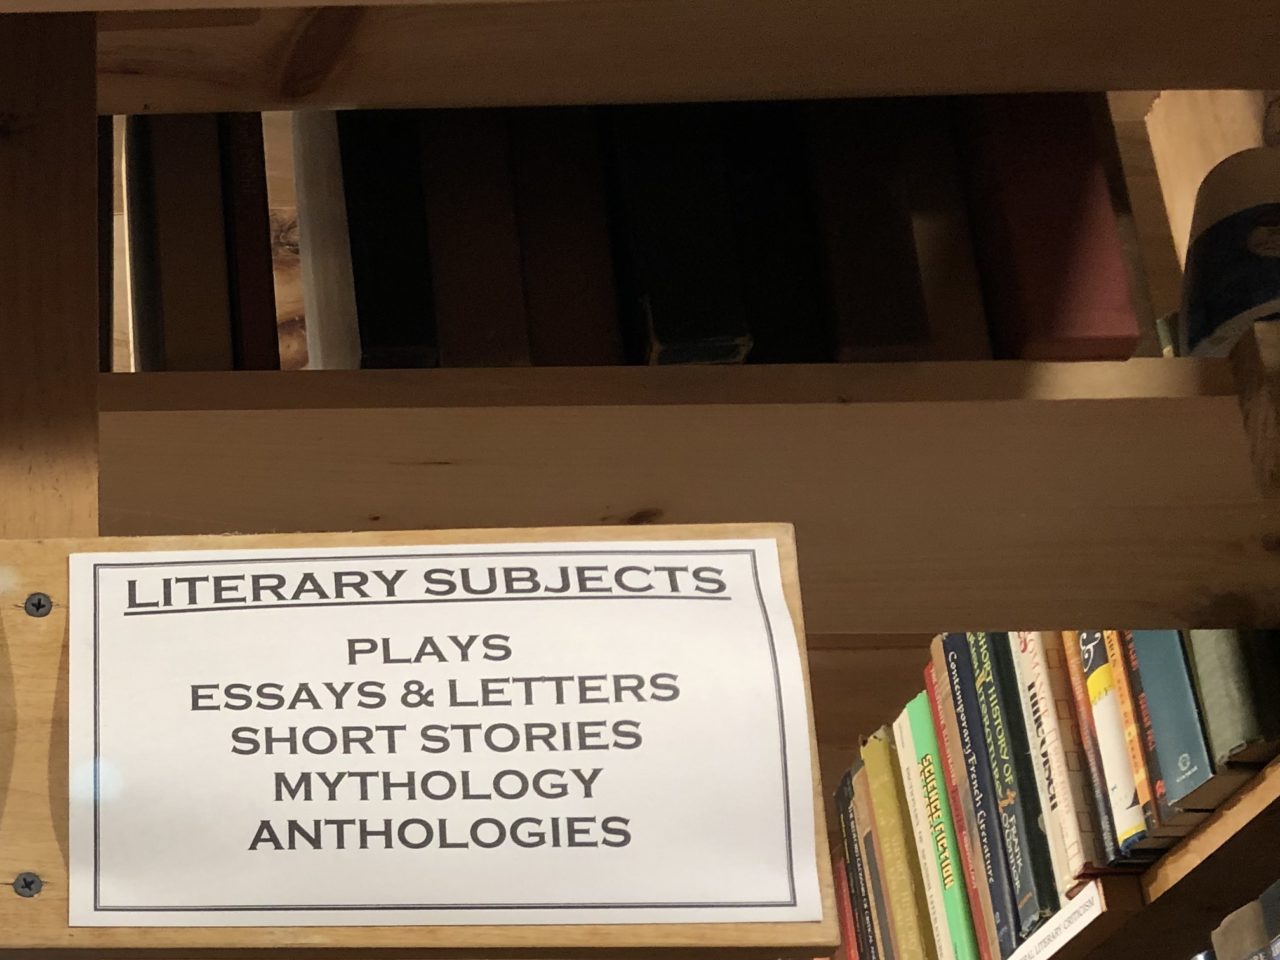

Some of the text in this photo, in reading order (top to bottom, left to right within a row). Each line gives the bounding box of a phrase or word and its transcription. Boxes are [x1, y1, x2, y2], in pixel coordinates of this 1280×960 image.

[126, 566, 729, 609] LITERARY SUBJECTS
[346, 634, 513, 665] PLAYS
[190, 672, 681, 712] ESSAYS & LETTERS
[229, 720, 643, 756] SHORT STORIES
[986, 686, 1009, 759] HISTORY
[1001, 763, 1014, 784] OF
[273, 768, 604, 801] MYTHOLOGY
[946, 650, 974, 754] Contemporary
[965, 753, 984, 807] French
[975, 809, 997, 883] Literature
[248, 816, 632, 851] ANTHOLOGIES
[920, 753, 943, 819] SCIENCE
[932, 821, 956, 891] FICTION
[1035, 926, 1062, 955] LITERARY
[1063, 897, 1095, 930] CRITICISM
